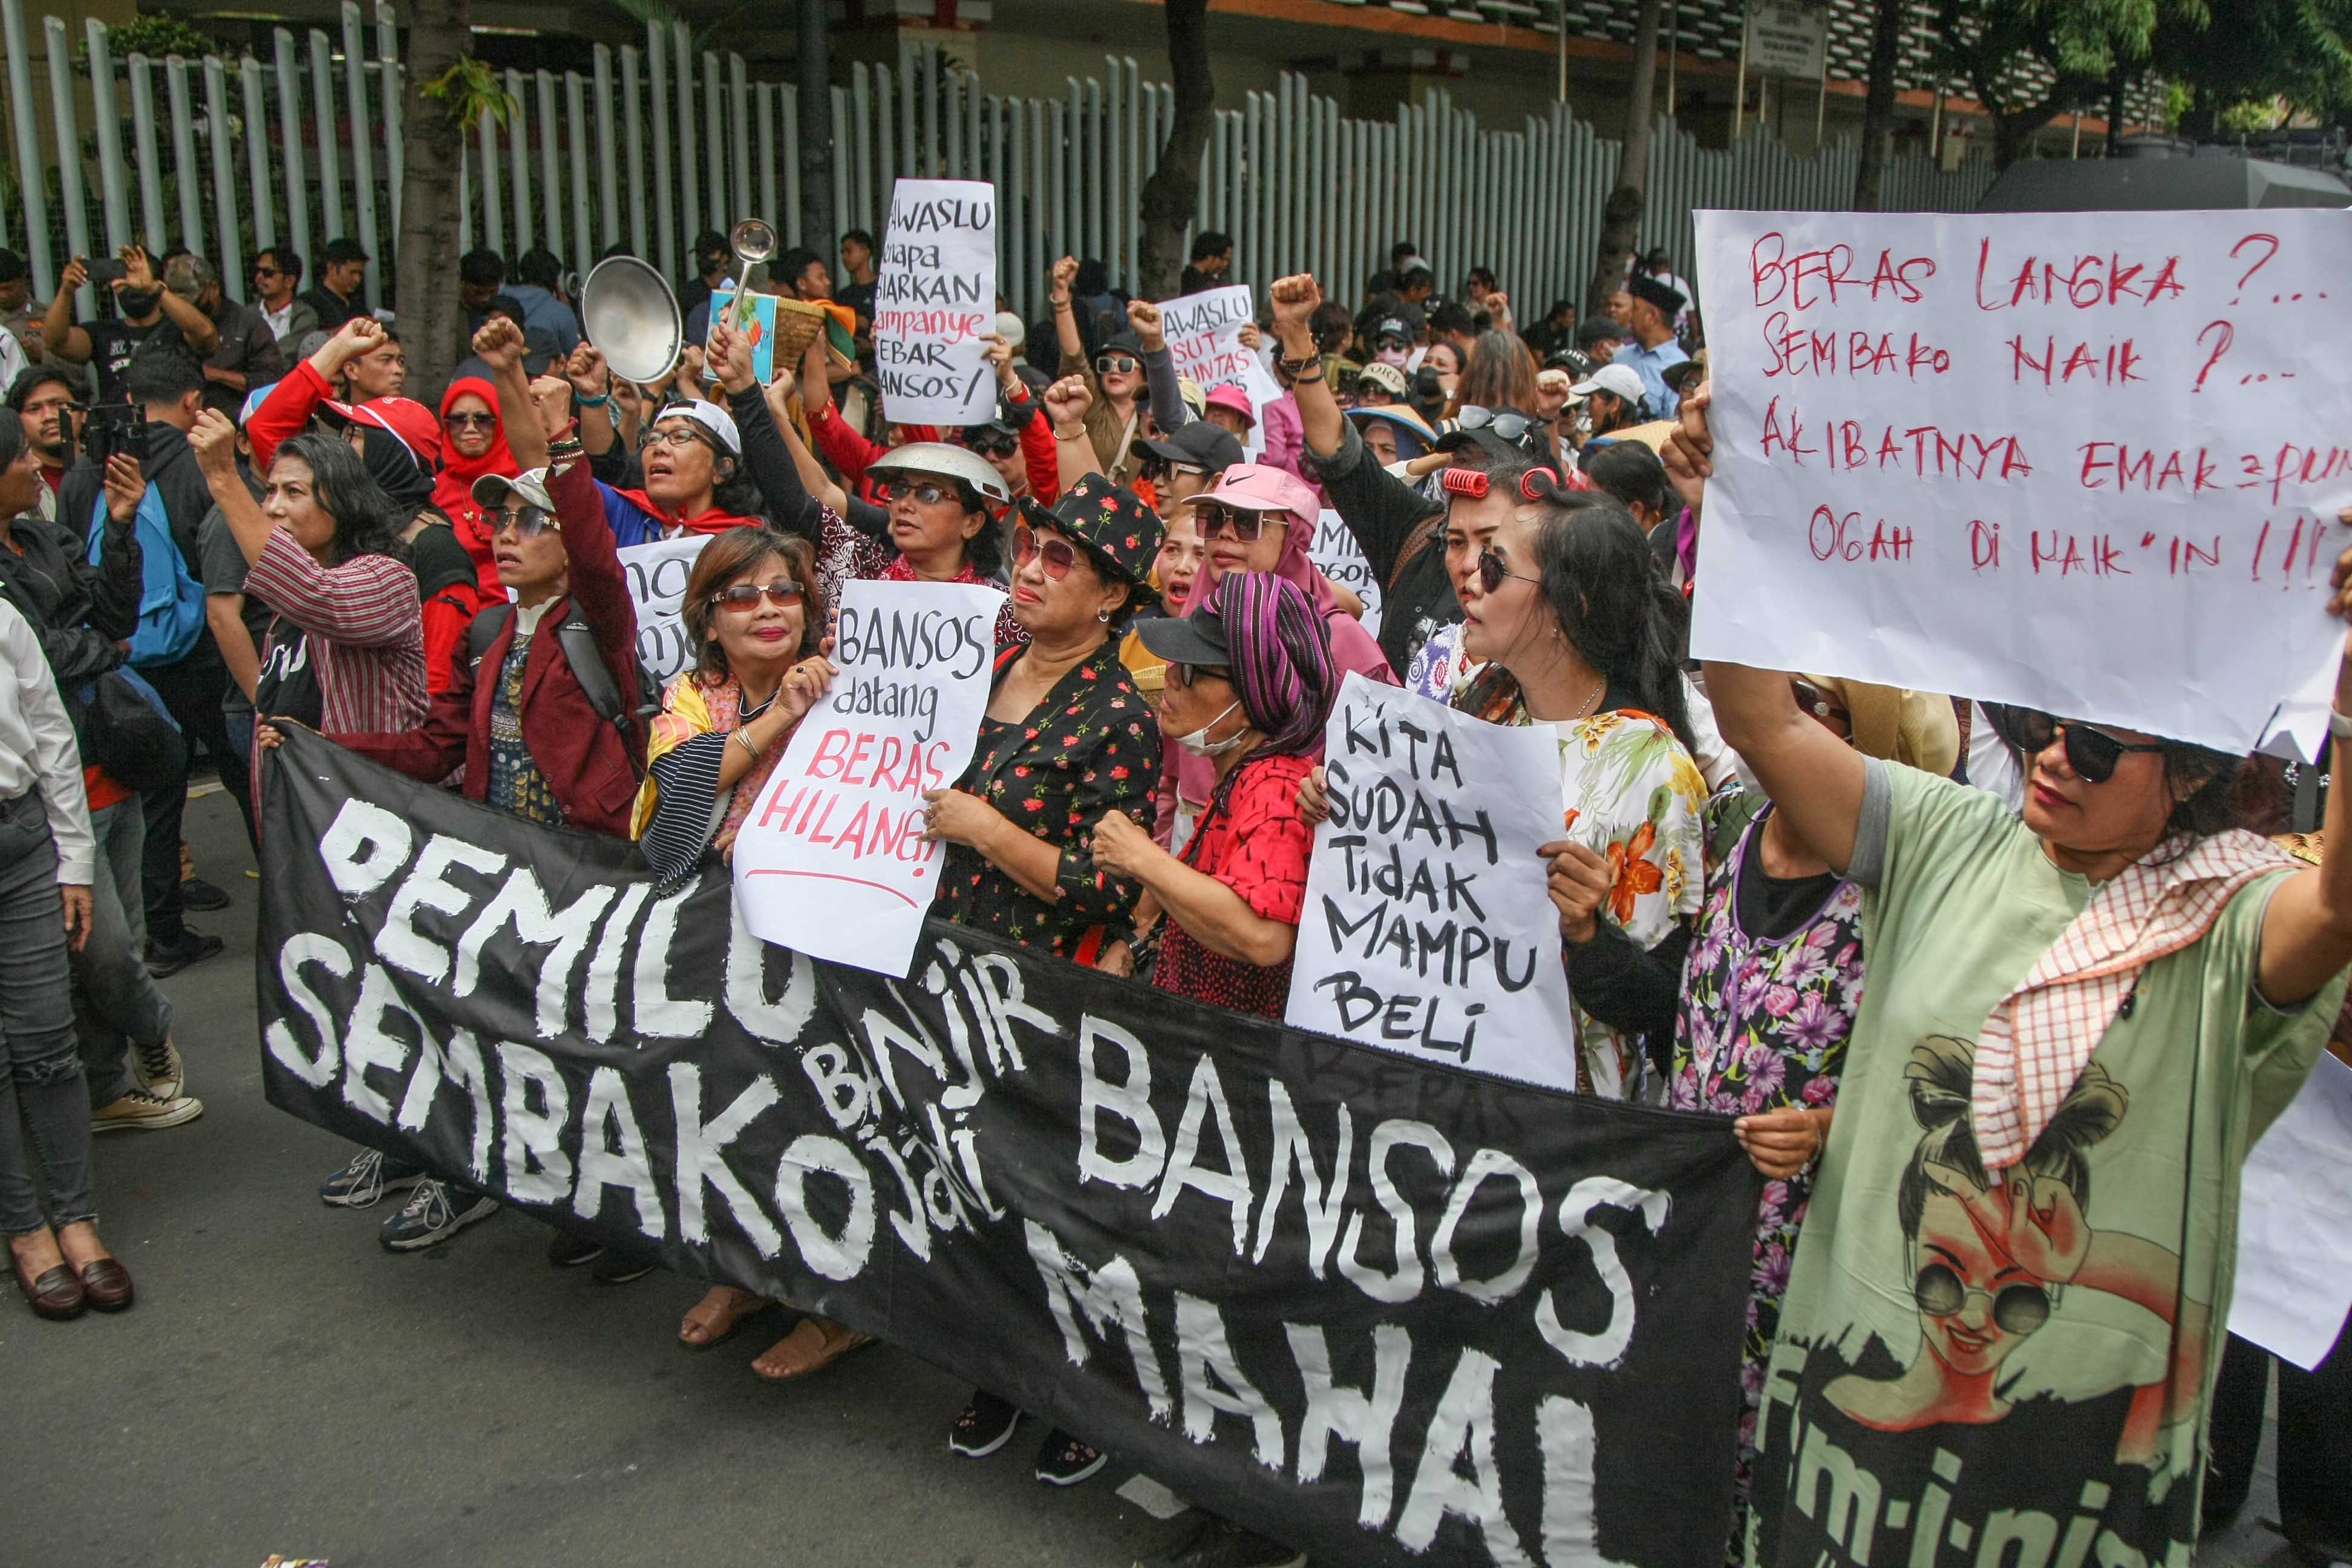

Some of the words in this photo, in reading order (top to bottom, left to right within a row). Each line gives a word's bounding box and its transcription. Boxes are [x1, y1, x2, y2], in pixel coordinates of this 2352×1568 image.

[1749, 231, 1936, 310] BERAS
[1975, 236, 2186, 310] LANGKA
[875, 309, 985, 344] ampanye
[877, 338, 956, 371] EBAR
[1760, 394, 2034, 482] AKIBATNYA
[1809, 504, 1913, 563] OGAH
[839, 607, 986, 680] BANSOS
[832, 675, 938, 743] datang
[805, 728, 951, 802] BERAS
[1322, 893, 1537, 993] MAMPU
[320, 797, 817, 1047] PEMILU
[1077, 1013, 1672, 1371] BANSOS
[265, 932, 877, 1281] SEMBAKO
[1024, 1217, 1641, 1568] MAHAL
